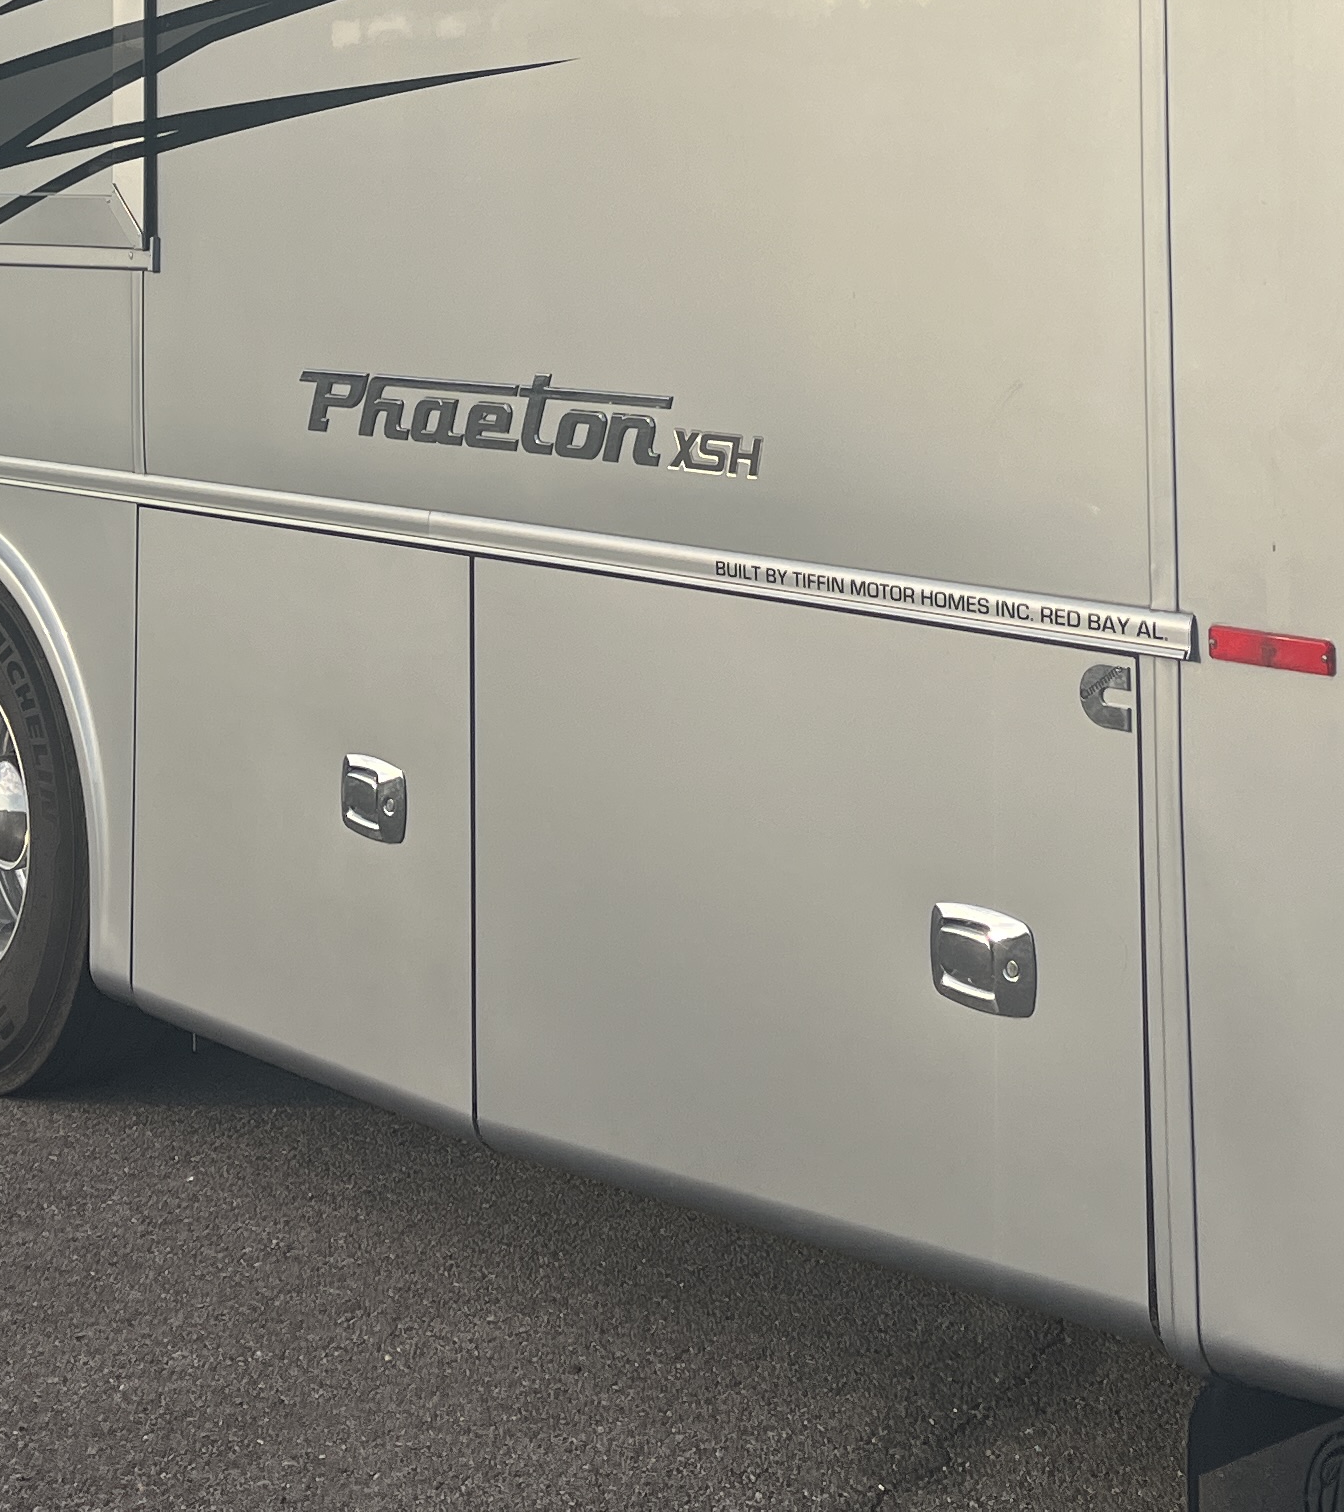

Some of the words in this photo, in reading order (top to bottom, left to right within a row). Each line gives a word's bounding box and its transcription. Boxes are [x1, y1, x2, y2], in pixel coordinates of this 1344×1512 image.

[299, 368, 674, 467] Phaeton
[667, 427, 764, 480] XSH
[715, 560, 761, 581] BUILT
[765, 567, 788, 585] BY
[792, 571, 845, 594] TIFFIN
[850, 579, 916, 604] MOTOR
[921, 589, 991, 615] HOMES
[995, 599, 1035, 622] INC.
[1040, 606, 1081, 629] RED
[1087, 612, 1131, 636] BAY
[1136, 619, 1169, 642] AL.
